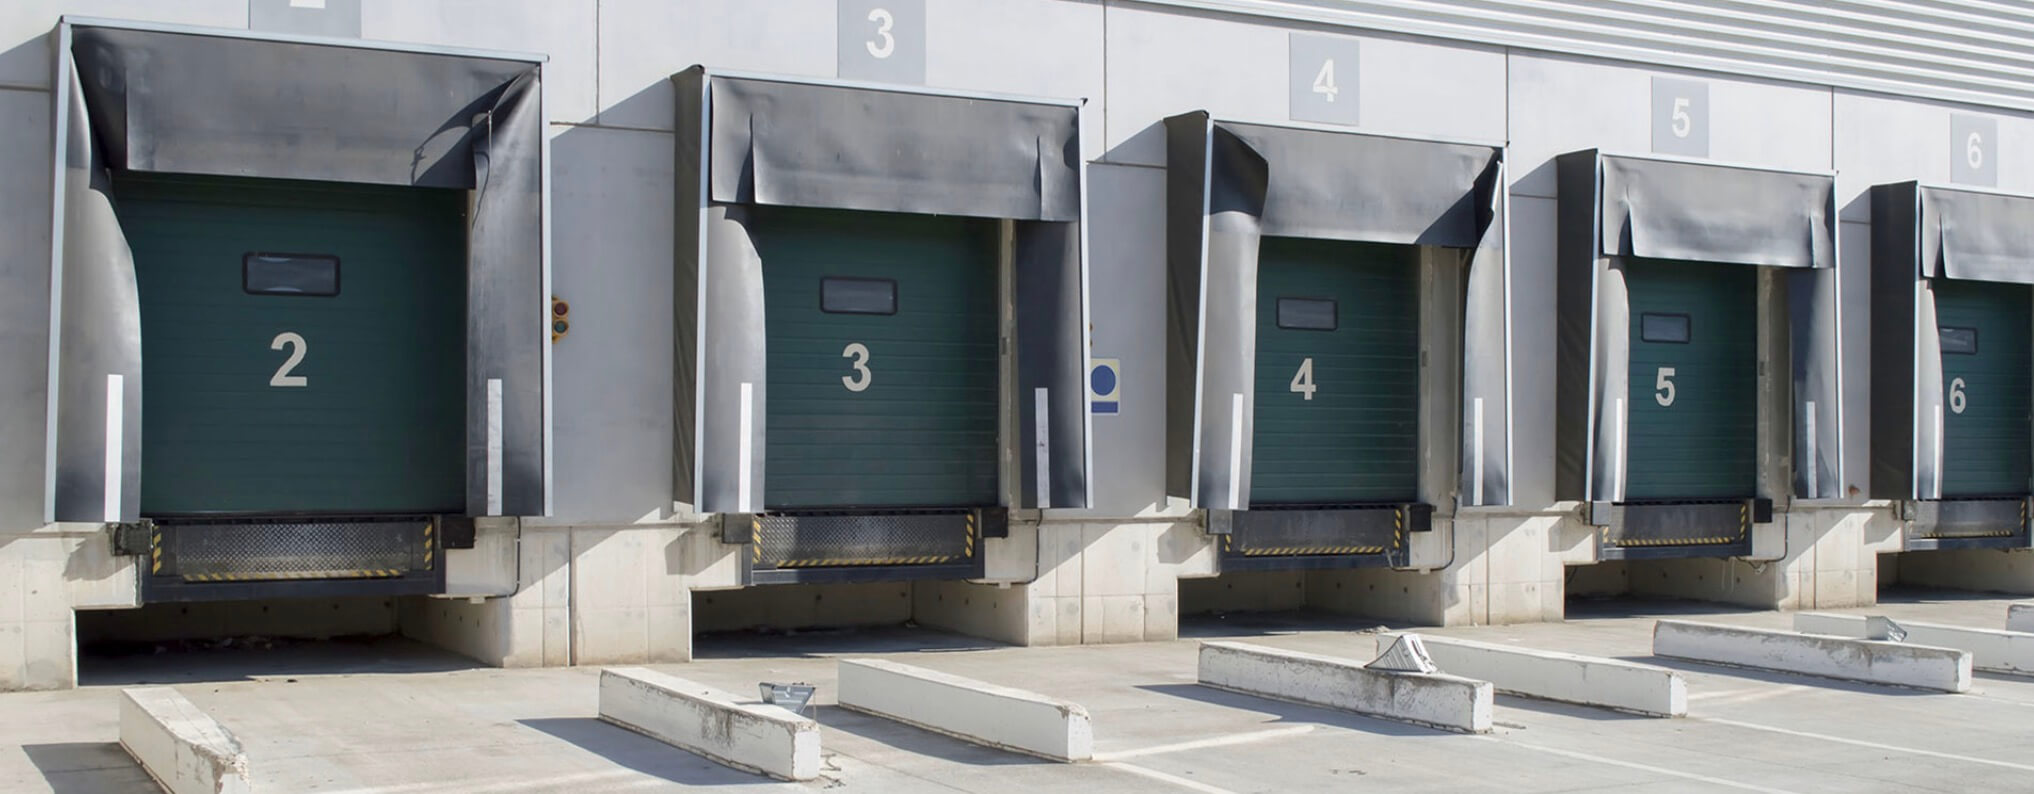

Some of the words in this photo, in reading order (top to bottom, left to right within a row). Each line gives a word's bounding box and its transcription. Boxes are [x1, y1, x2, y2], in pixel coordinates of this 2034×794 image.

[867, 9, 895, 58] 3
[1311, 59, 1338, 102] 4
[1671, 98, 1691, 138] 5
[1967, 132, 1983, 169] 6
[270, 332, 307, 387] 2
[842, 343, 872, 391] 3
[1290, 358, 1317, 401] 4
[1655, 367, 1676, 407] 5
[1949, 377, 1966, 413] 6
